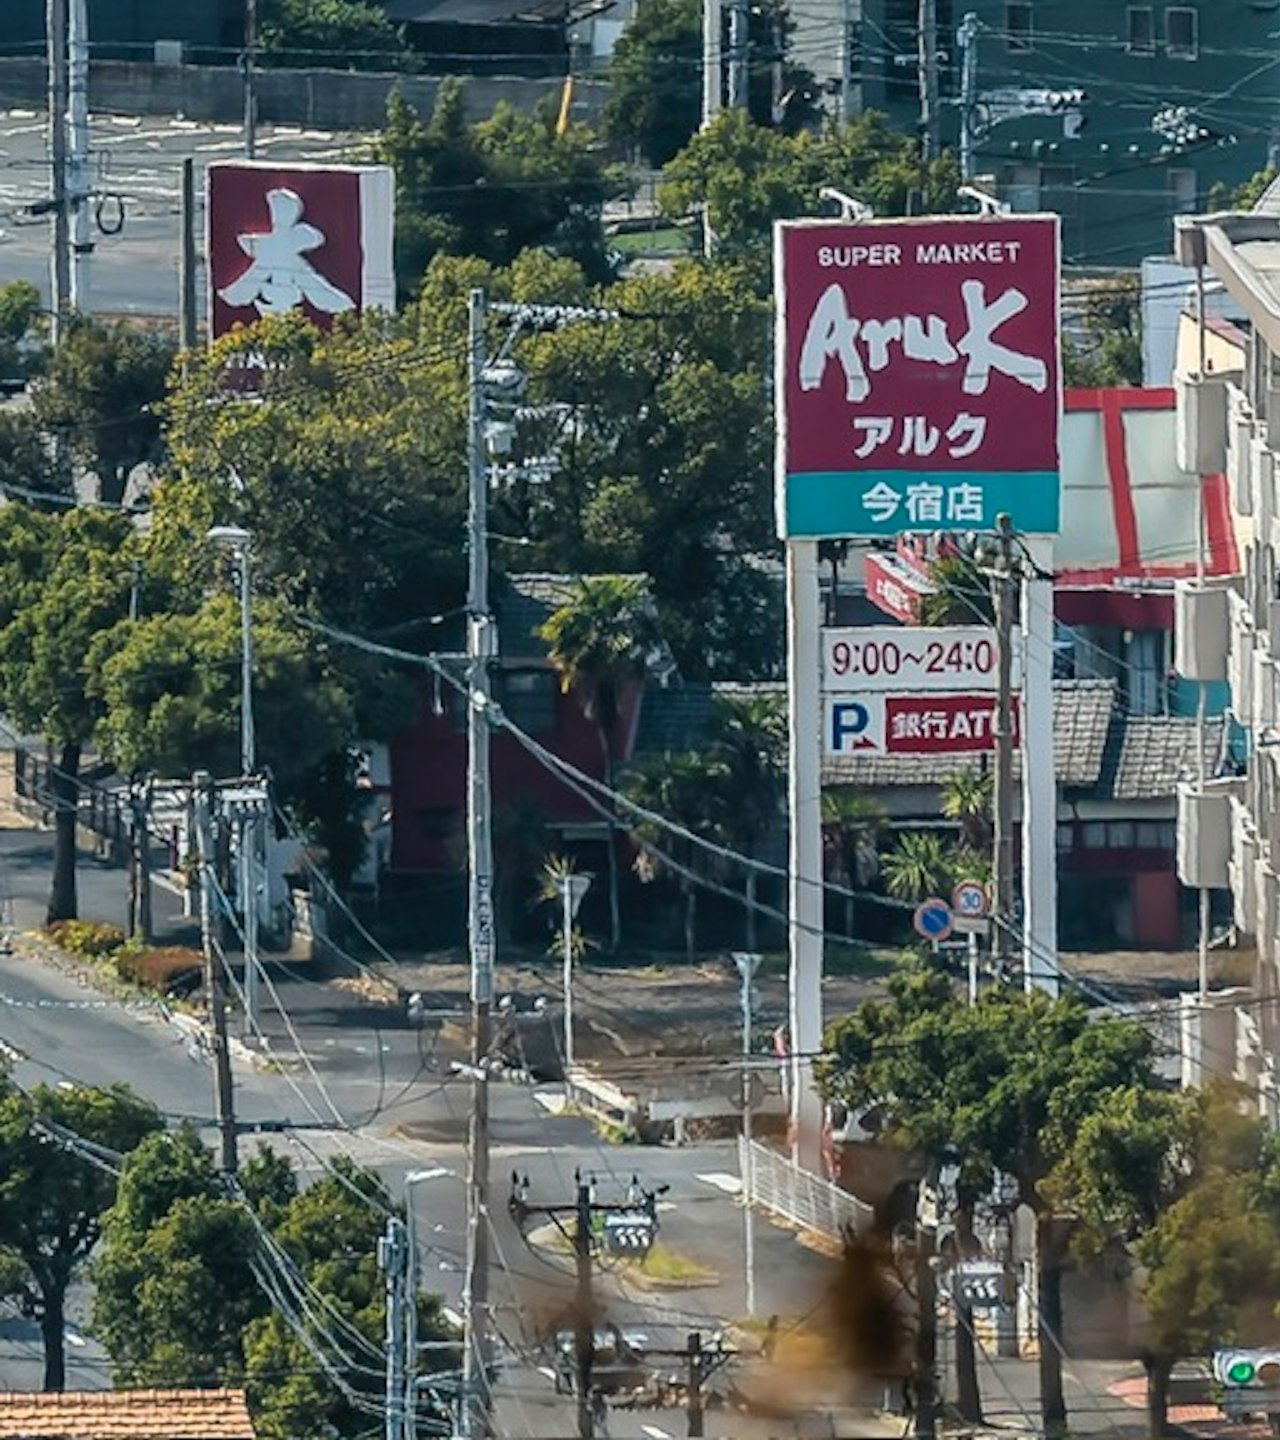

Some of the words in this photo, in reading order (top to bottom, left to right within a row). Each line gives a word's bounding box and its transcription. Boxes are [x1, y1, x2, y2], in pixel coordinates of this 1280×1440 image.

[818, 245, 901, 268] SUPER
[916, 240, 1022, 266] MARKET
[853, 413, 987, 460] アルク
[861, 481, 984, 524] 今宿店
[831, 640, 996, 676] 9:00~24:0
[832, 703, 869, 750] P
